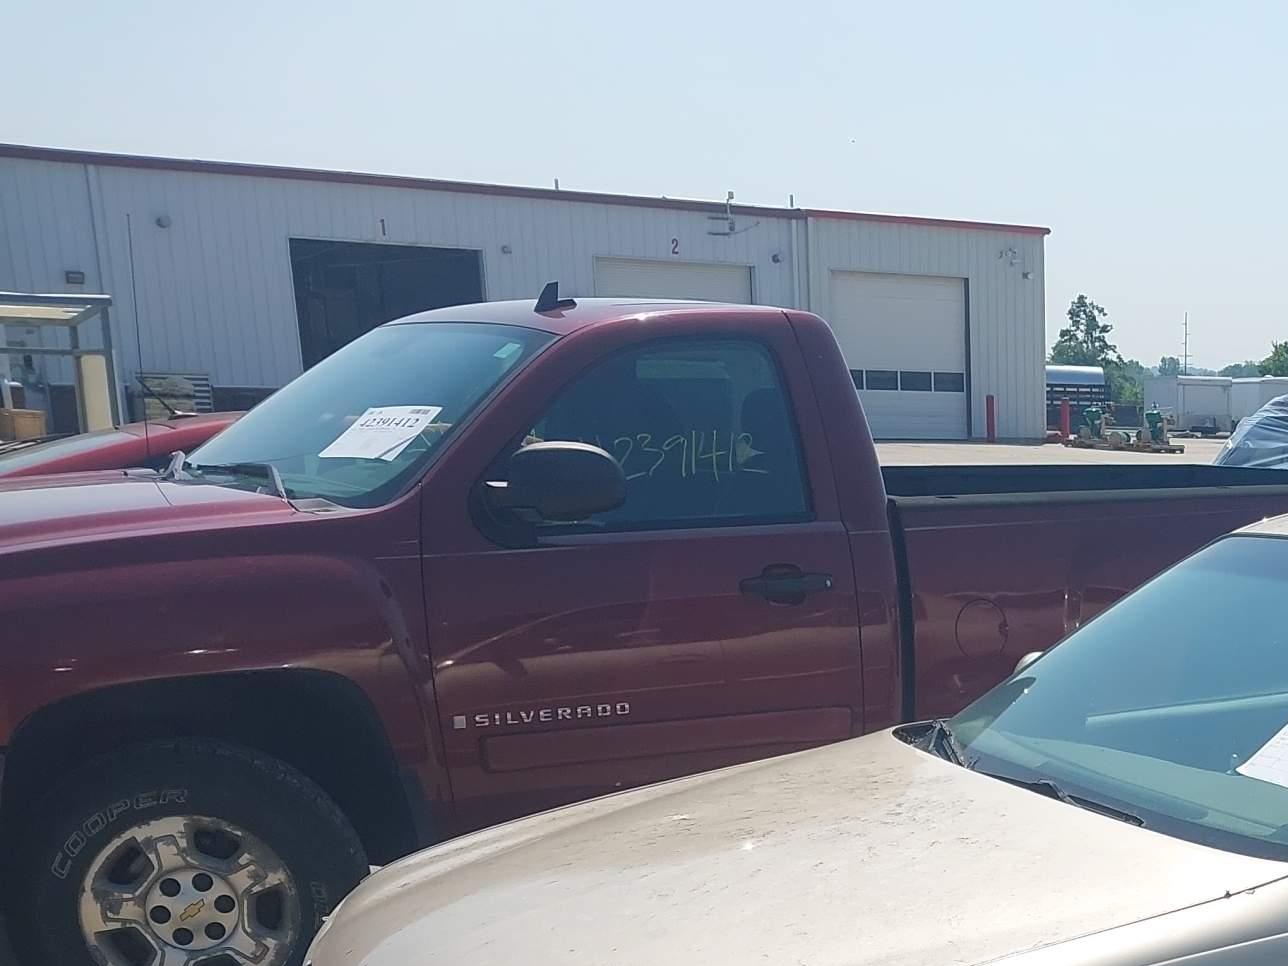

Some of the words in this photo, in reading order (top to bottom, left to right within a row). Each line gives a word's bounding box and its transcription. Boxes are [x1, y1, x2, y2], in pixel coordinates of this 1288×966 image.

[379, 218, 387, 237] 1
[671, 237, 680, 255] 2
[475, 701, 631, 727] SILVERADO
[51, 788, 190, 880] COOPER
